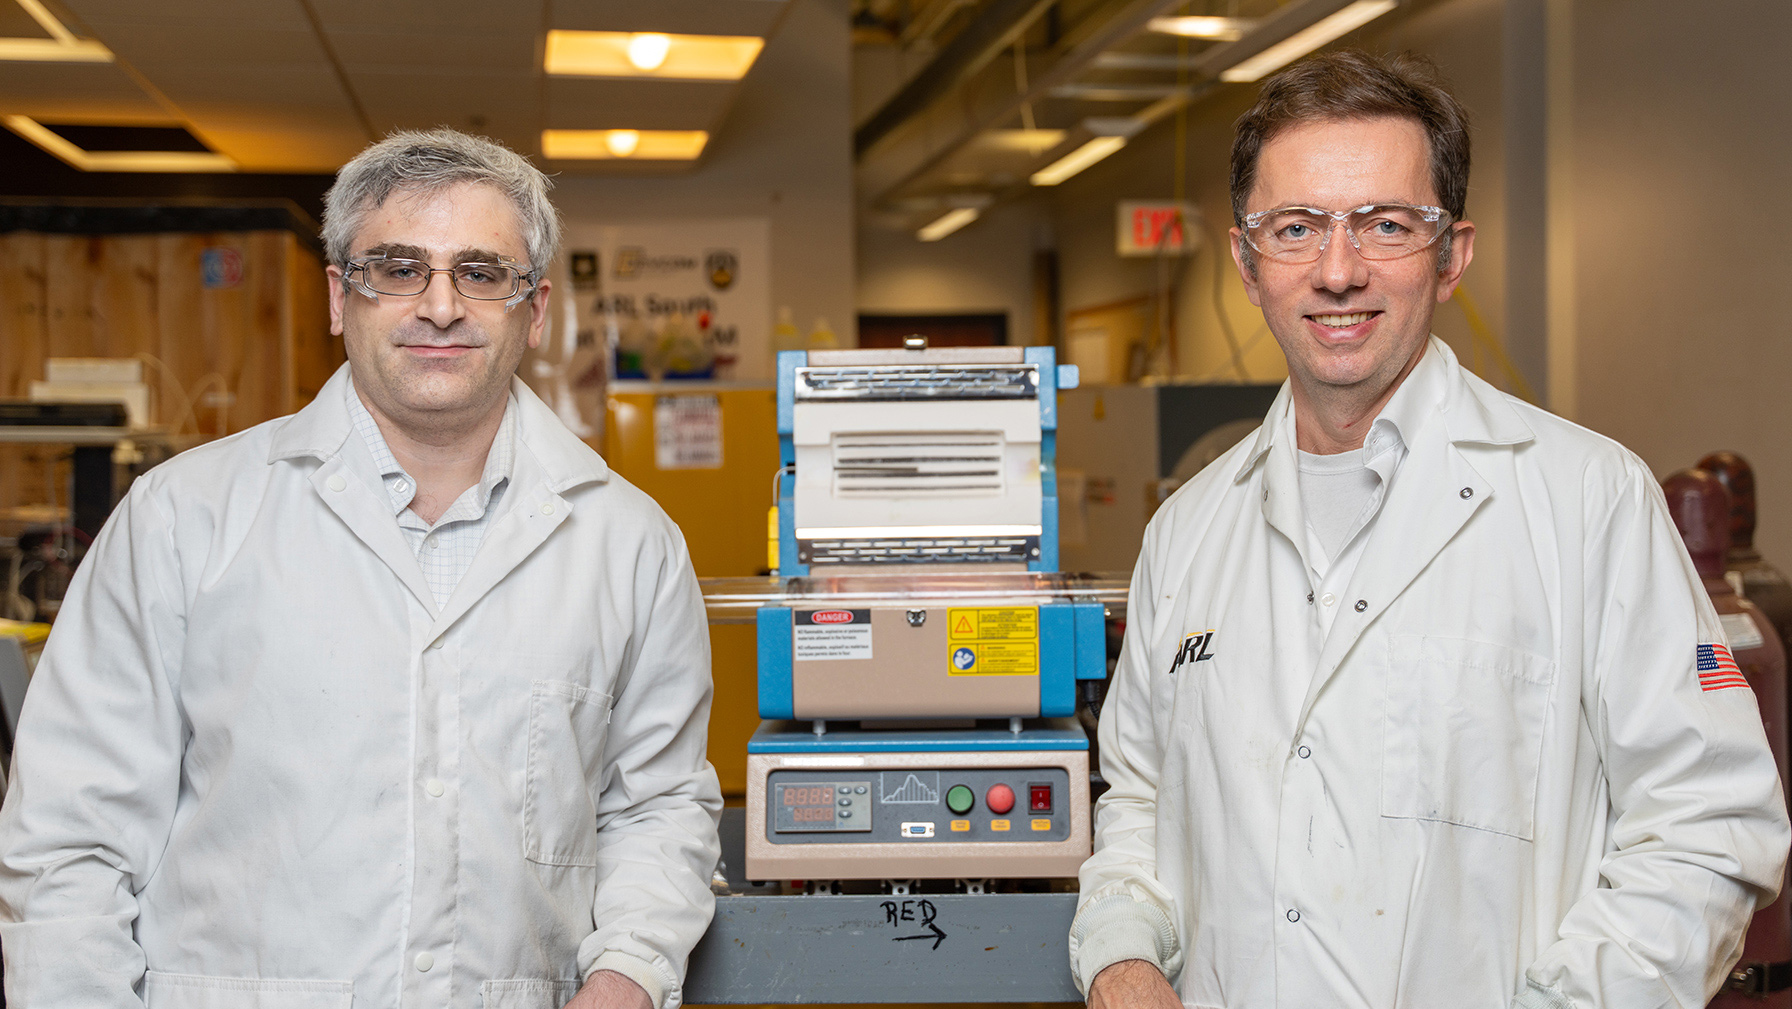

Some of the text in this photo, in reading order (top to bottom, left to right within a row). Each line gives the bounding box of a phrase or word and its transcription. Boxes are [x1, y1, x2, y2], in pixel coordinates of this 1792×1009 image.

[816, 613, 849, 621] DANGER
[1169, 628, 1216, 674] ARL
[880, 899, 937, 928] RED
